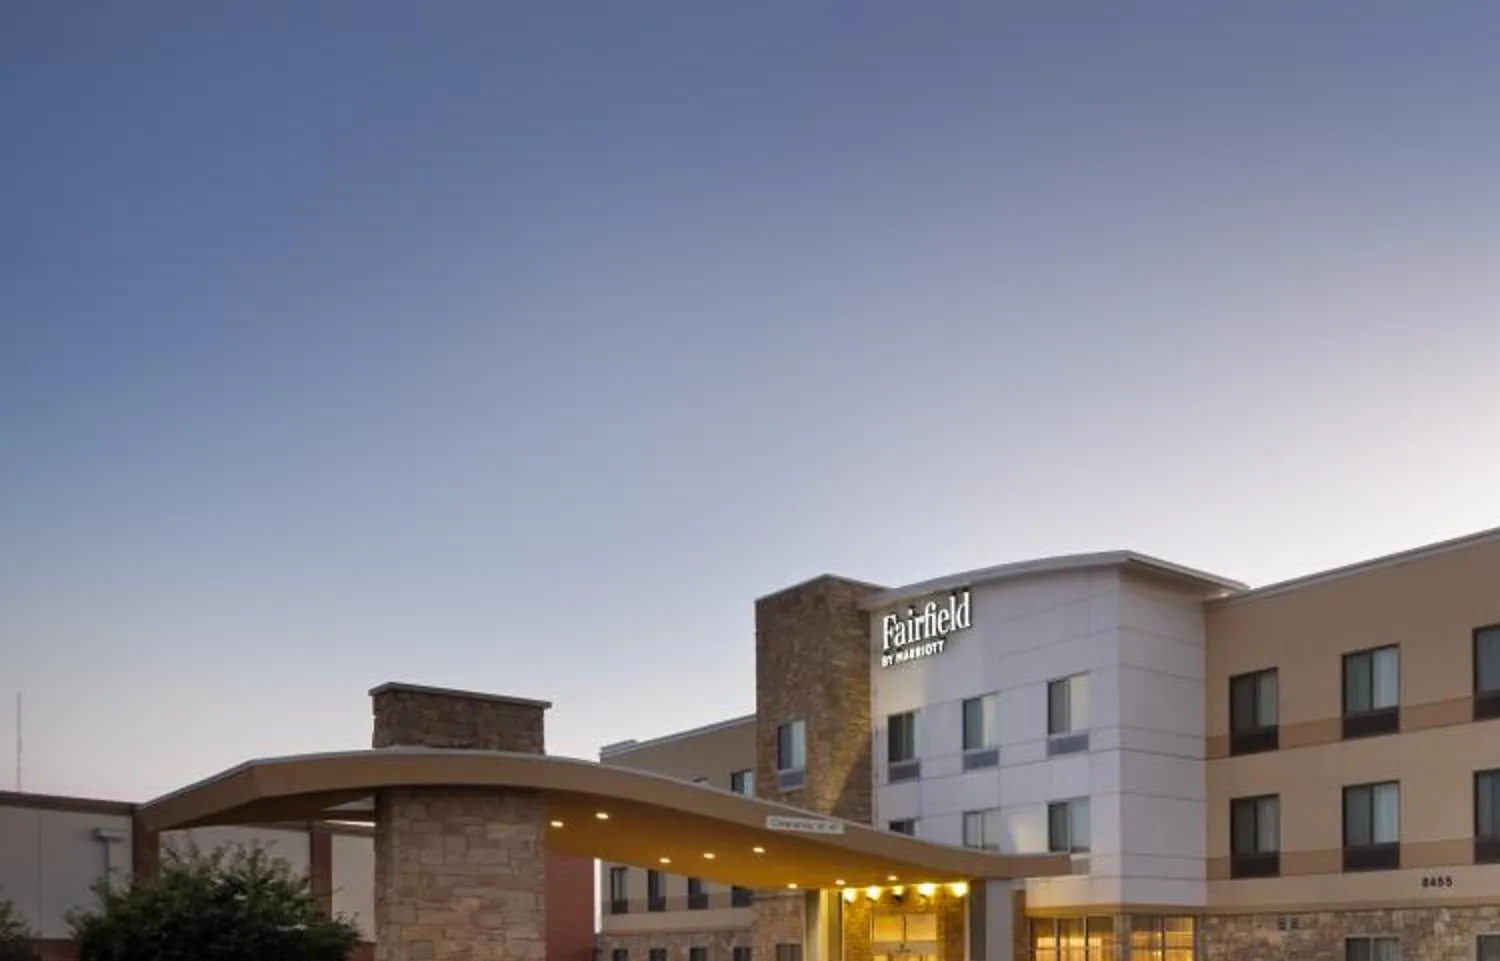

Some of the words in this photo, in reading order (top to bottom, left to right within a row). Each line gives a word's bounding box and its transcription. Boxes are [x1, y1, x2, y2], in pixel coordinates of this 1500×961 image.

[883, 591, 971, 650] Fairfield
[881, 655, 893, 668] BY
[896, 640, 945, 662] MARRIOTT
